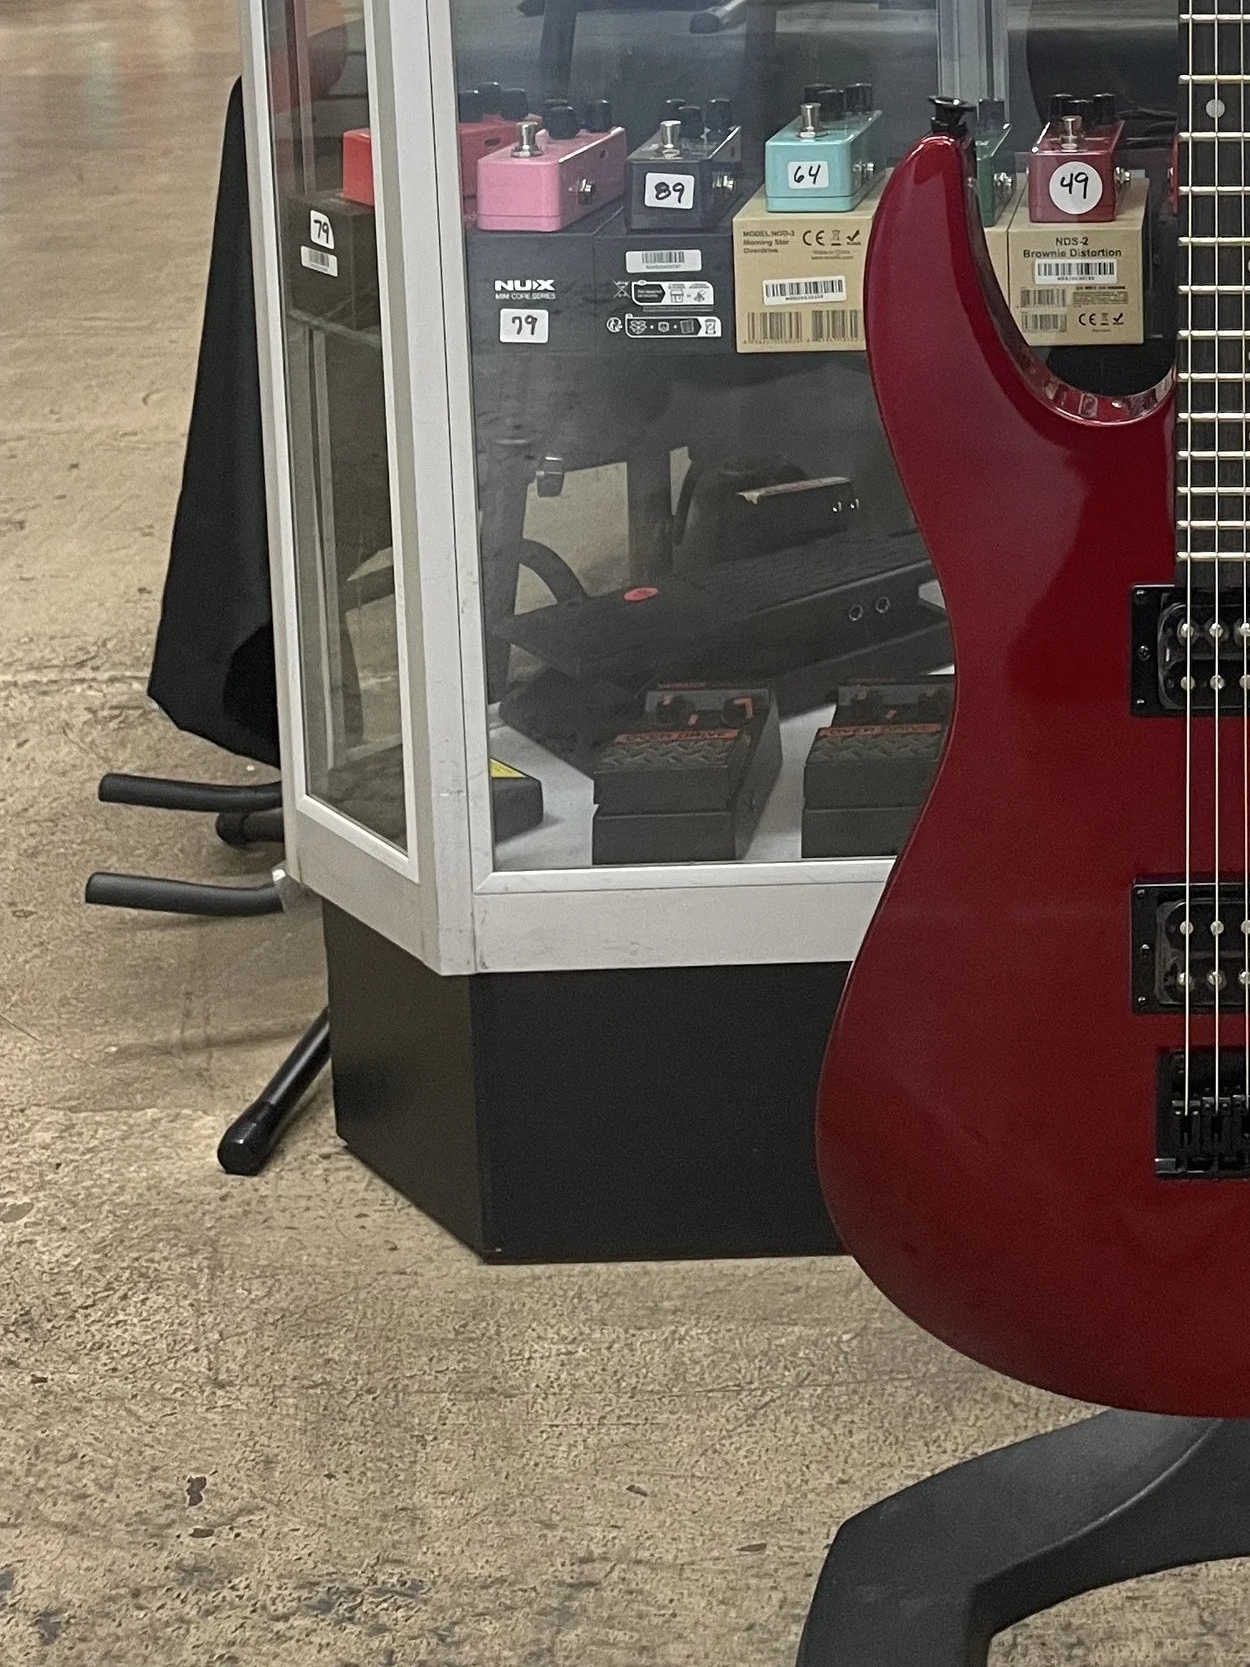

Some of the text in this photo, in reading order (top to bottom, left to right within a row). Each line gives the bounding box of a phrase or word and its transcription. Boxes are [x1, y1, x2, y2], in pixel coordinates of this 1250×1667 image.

[793, 164, 821, 185] 64
[1059, 171, 1089, 199] 49
[654, 181, 685, 203] 89
[313, 219, 330, 244] 79
[1055, 236, 1089, 246] NDS-2
[1023, 248, 1122, 258] Brownie Distortion
[494, 279, 556, 291] NUX
[511, 314, 538, 335] 79
